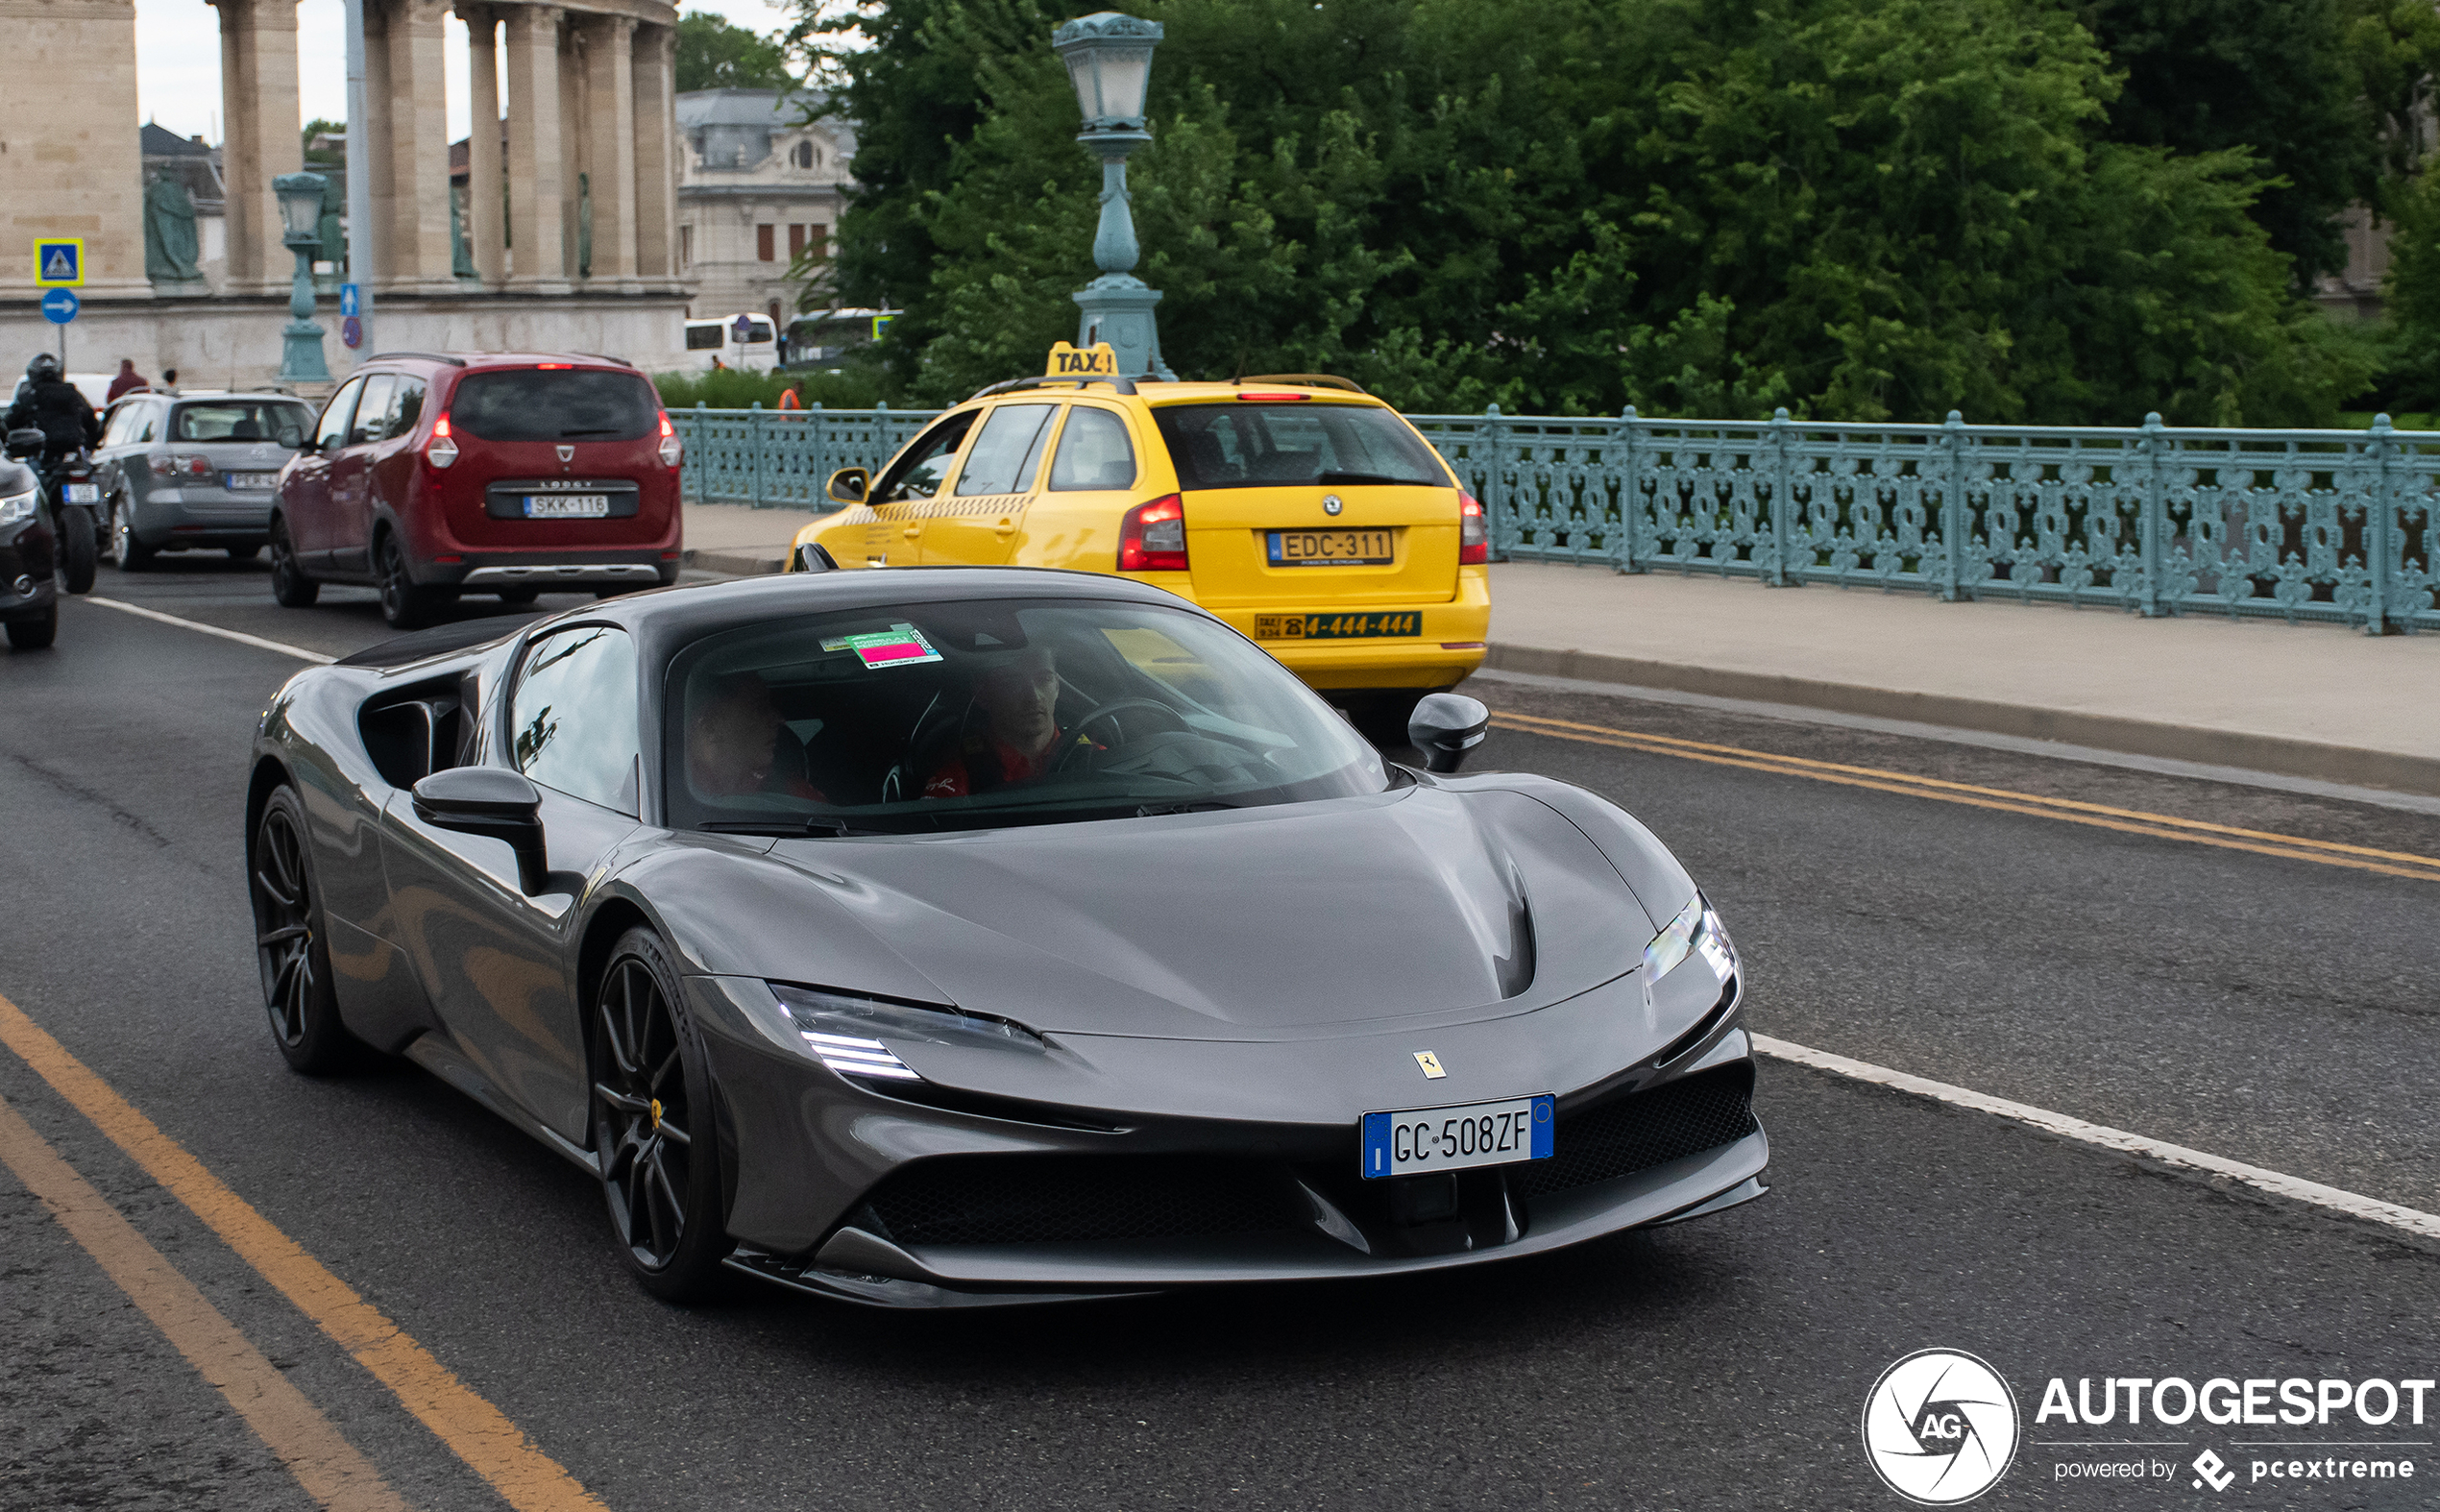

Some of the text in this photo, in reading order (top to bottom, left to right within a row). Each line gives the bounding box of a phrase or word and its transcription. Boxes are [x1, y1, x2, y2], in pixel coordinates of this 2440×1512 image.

[536, 496, 606, 513] SKK-116
[1285, 534, 1384, 557] EDC-311
[1306, 615, 1414, 636] 4-444-444
